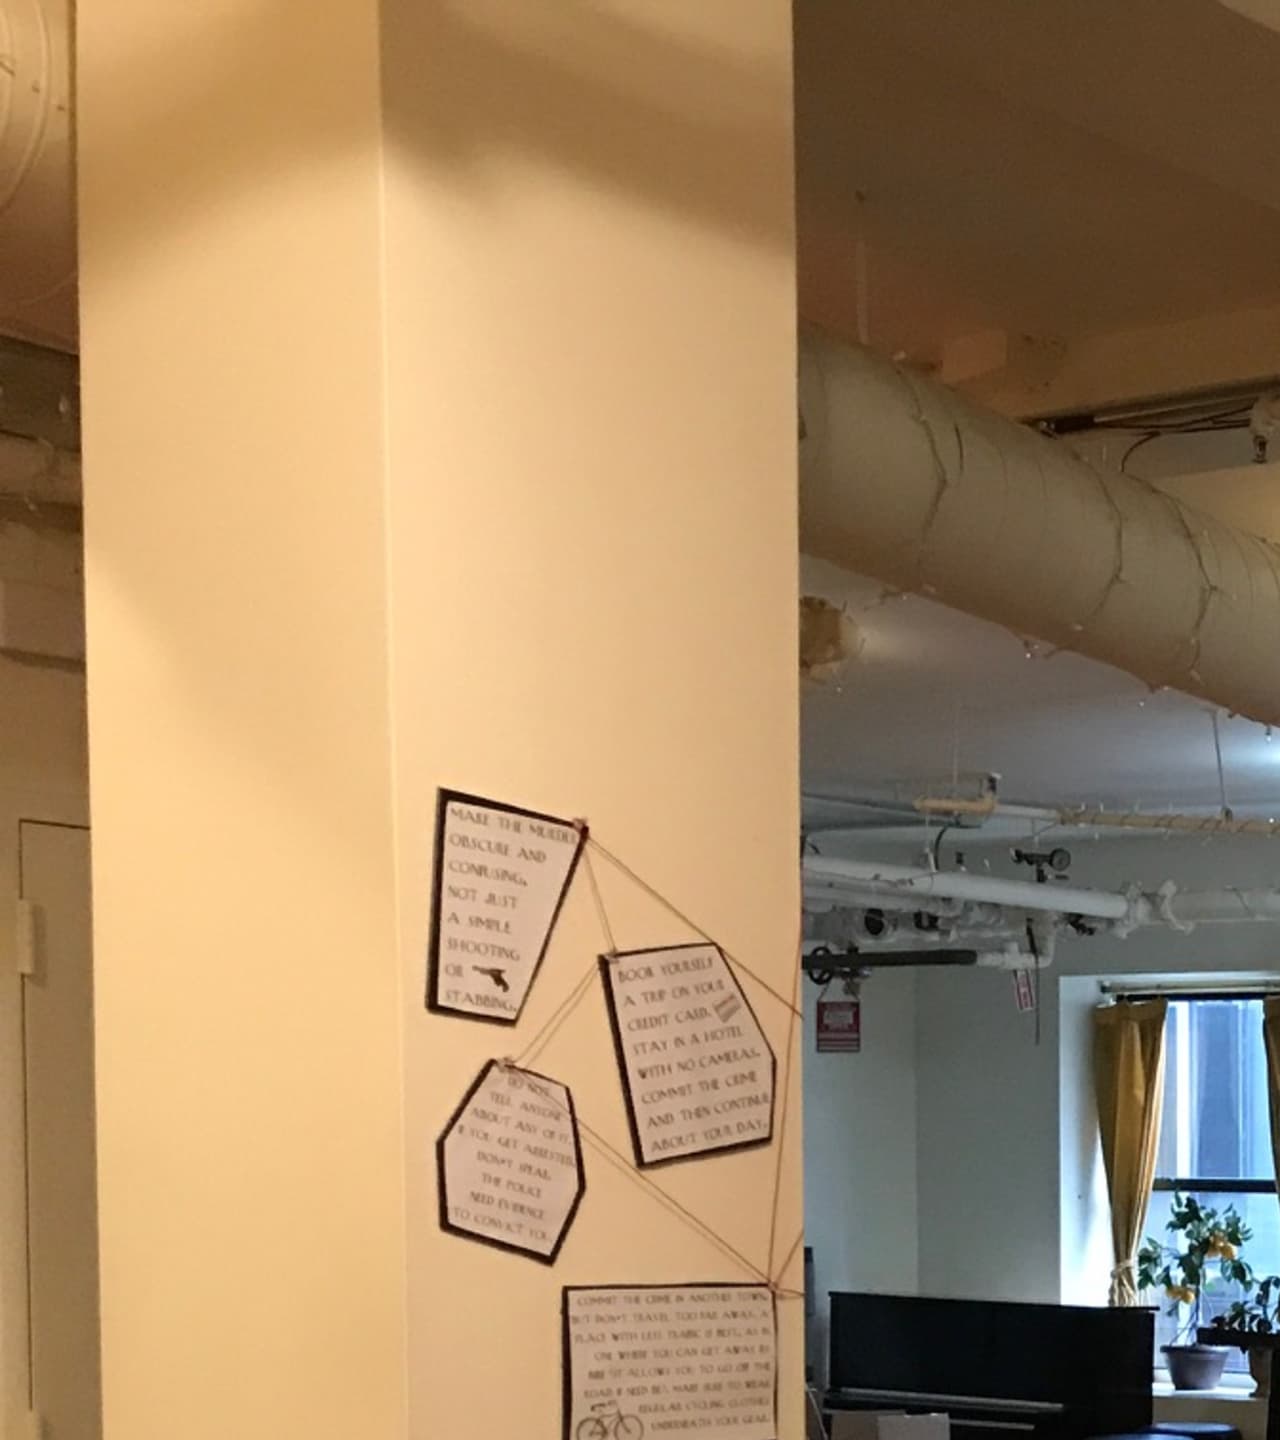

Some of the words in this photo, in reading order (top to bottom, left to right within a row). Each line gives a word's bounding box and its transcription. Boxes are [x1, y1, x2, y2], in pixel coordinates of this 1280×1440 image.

[451, 807, 489, 826] MAKE
[497, 817, 520, 833] THE
[448, 833, 509, 856] OBSCURE
[517, 846, 547, 863] AND
[447, 885, 477, 901] NOT
[485, 892, 518, 909] JUST
[447, 912, 460, 925] A
[468, 916, 512, 934] SIMPLE
[447, 937, 520, 961] SHOOTING
[445, 964, 464, 978] OR
[618, 965, 654, 984] BOOK
[660, 957, 714, 976] YOURSELF
[640, 988, 667, 1004] TRIP
[672, 985, 689, 999] ON
[694, 979, 725, 995] YOUR
[627, 1013, 670, 1032] CREDIT
[633, 1040, 668, 1056] STAY
[673, 1036, 686, 1048] IN
[703, 1025, 744, 1043] HOTEL
[637, 1063, 672, 1080] WITH
[677, 1058, 696, 1072] NO
[641, 1084, 693, 1105] COMMIT
[698, 1078, 720, 1092] THE
[724, 1070, 757, 1088] CRIME
[647, 1113, 675, 1129] AND
[679, 1105, 711, 1121] THEN
[713, 1091, 769, 1115] CONTINUE
[650, 1133, 698, 1152] ABOUT
[703, 1124, 733, 1140] YOUR
[736, 1118, 768, 1136] DAY.
